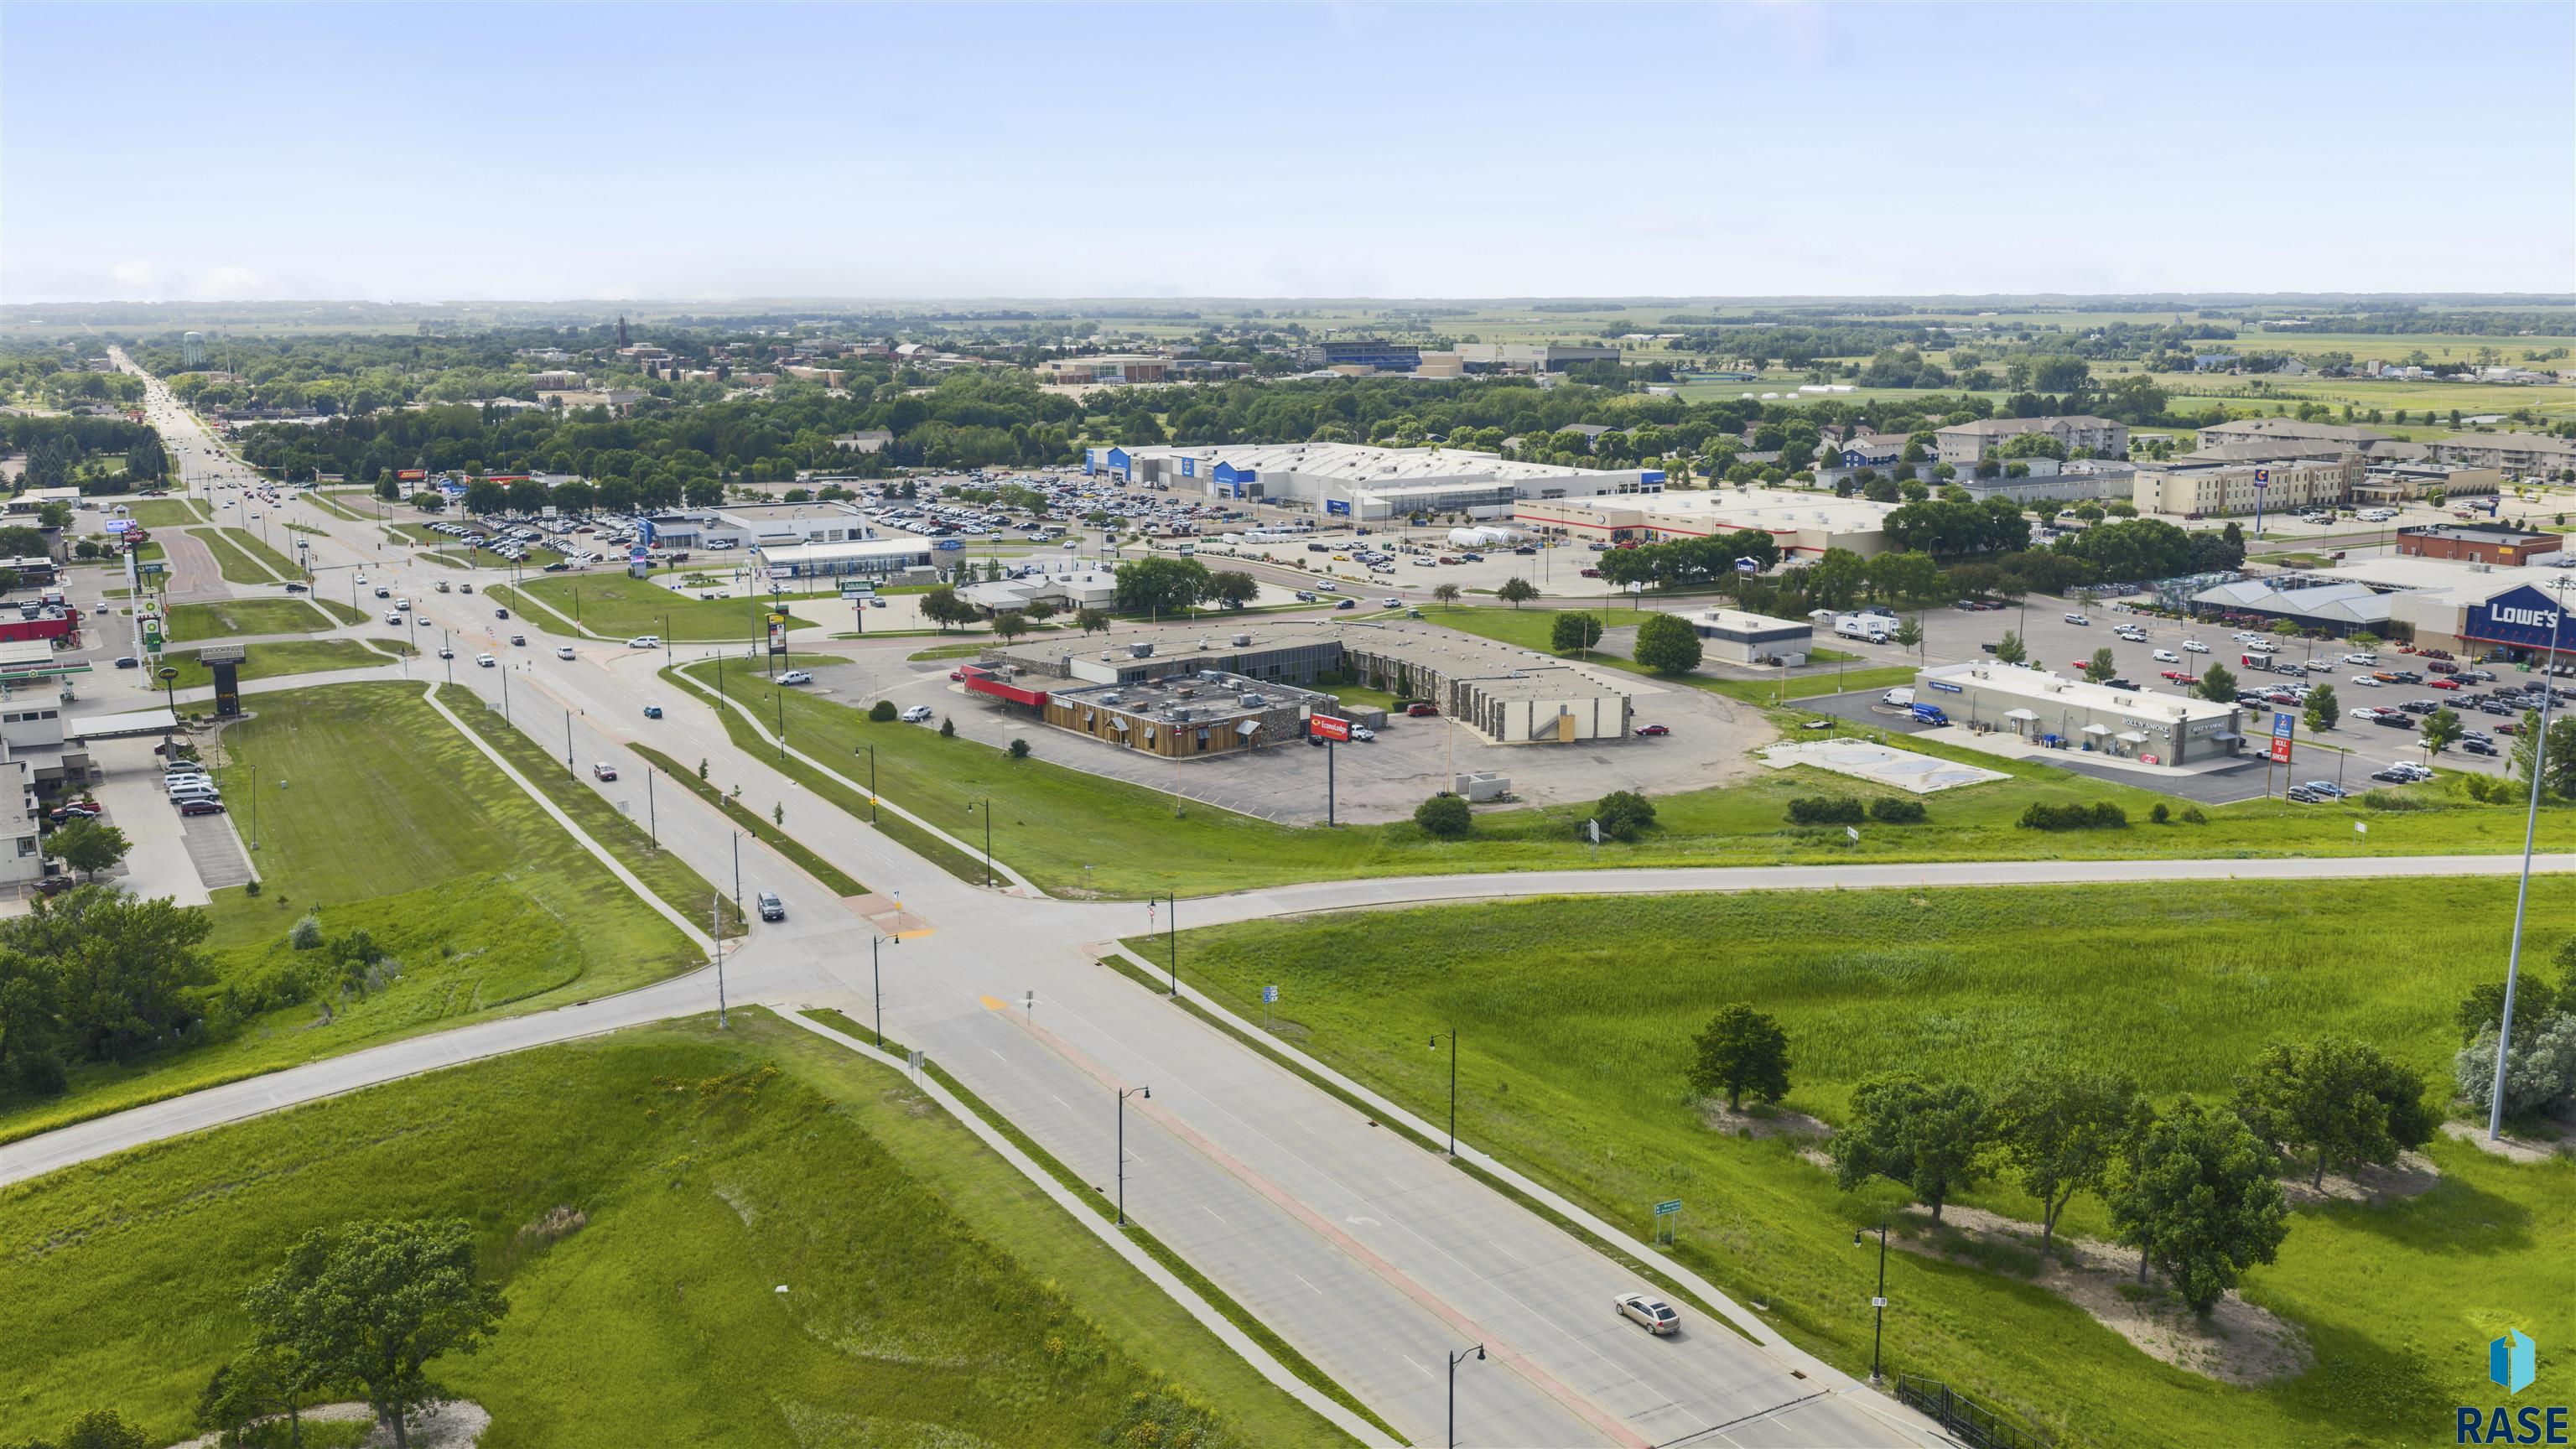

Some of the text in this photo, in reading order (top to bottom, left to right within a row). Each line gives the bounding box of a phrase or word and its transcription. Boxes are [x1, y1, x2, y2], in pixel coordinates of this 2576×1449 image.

[1737, 563, 1754, 571] LOWE'S
[2491, 604, 2558, 628] LOWE'S
[2122, 718, 2140, 727] ROLL
[2146, 722, 2169, 733] SMOKE
[2272, 753, 2288, 761] SMOKE
